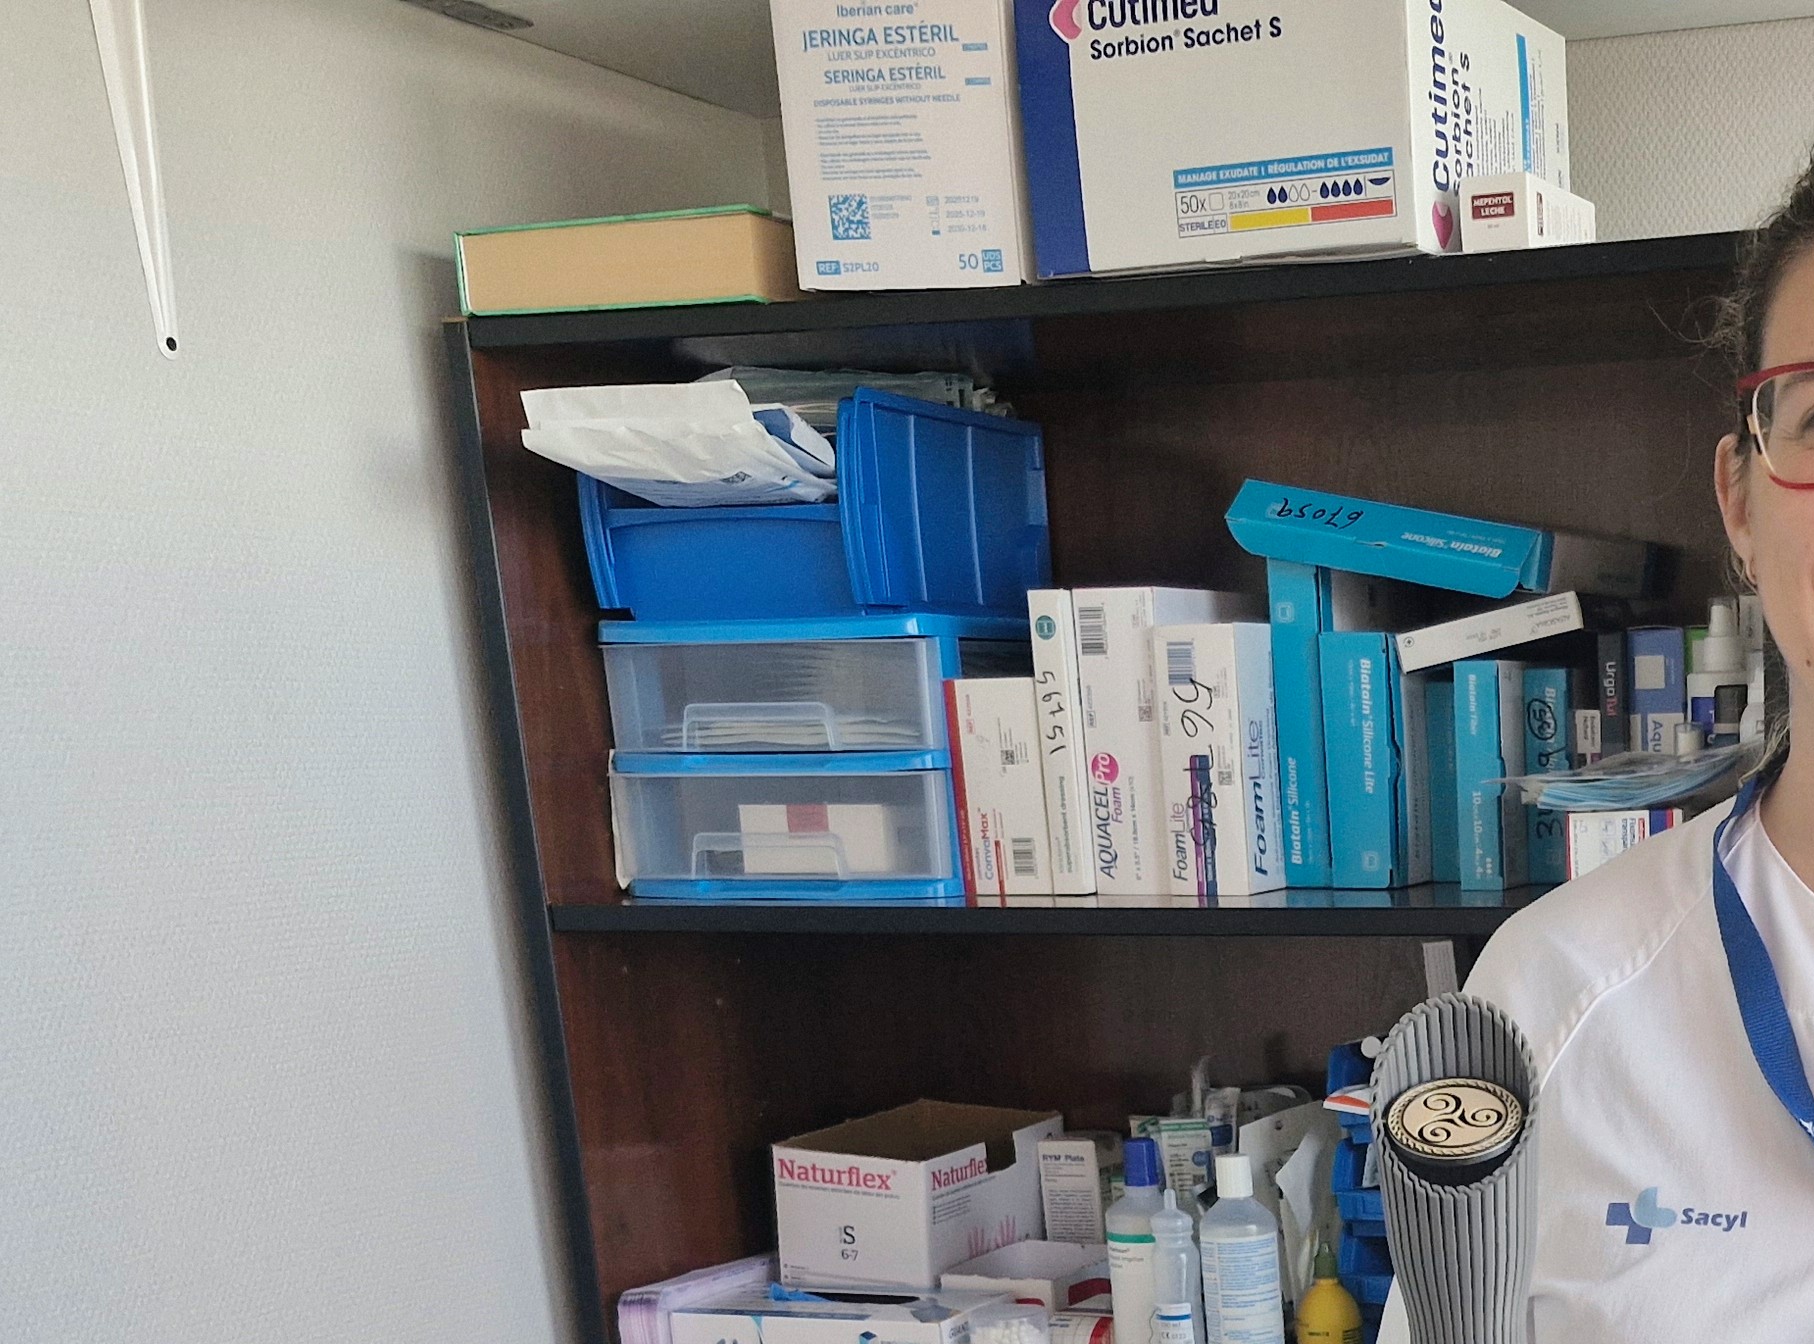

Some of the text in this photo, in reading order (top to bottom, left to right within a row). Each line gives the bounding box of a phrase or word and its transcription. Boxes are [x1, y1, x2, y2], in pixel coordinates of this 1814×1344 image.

[836, 5, 914, 17] Iberian care
[802, 20, 959, 52] JERINGA ESTÉRIL
[1090, 17, 1282, 60] Sorbion Sachet S
[827, 51, 851, 61] LUER
[824, 63, 946, 84] SERINGA ESTÉRIL
[1461, 82, 1474, 177] achet
[1178, 171, 1217, 184] MANAGE
[1219, 166, 1258, 180] EXUDATE
[1267, 160, 1324, 174] RÉGULATION
[1328, 157, 1340, 168] DE
[1179, 220, 1214, 233] STERILE
[818, 263, 839, 273] REF
[958, 253, 979, 270] 50
[984, 261, 1001, 271] PCS
[1400, 531, 1445, 549] Silicone
[1450, 540, 1503, 559] Biatain
[1603, 661, 1618, 717] UrgoTul
[1359, 658, 1375, 794] Biatain Silicone Lite
[1111, 786, 1123, 823] Foam
[1247, 720, 1268, 876] FoamLite
[1286, 757, 1303, 865] Biatain Silicone
[1093, 754, 1117, 879] AQUACEL Pro
[980, 813, 994, 880] ConvaMax
[1170, 803, 1188, 881] FoamLite
[777, 1158, 891, 1191] Naturflex
[1680, 1207, 1748, 1232] Sacyl
[843, 1225, 856, 1244] S
[841, 1249, 858, 1261] 6-7
